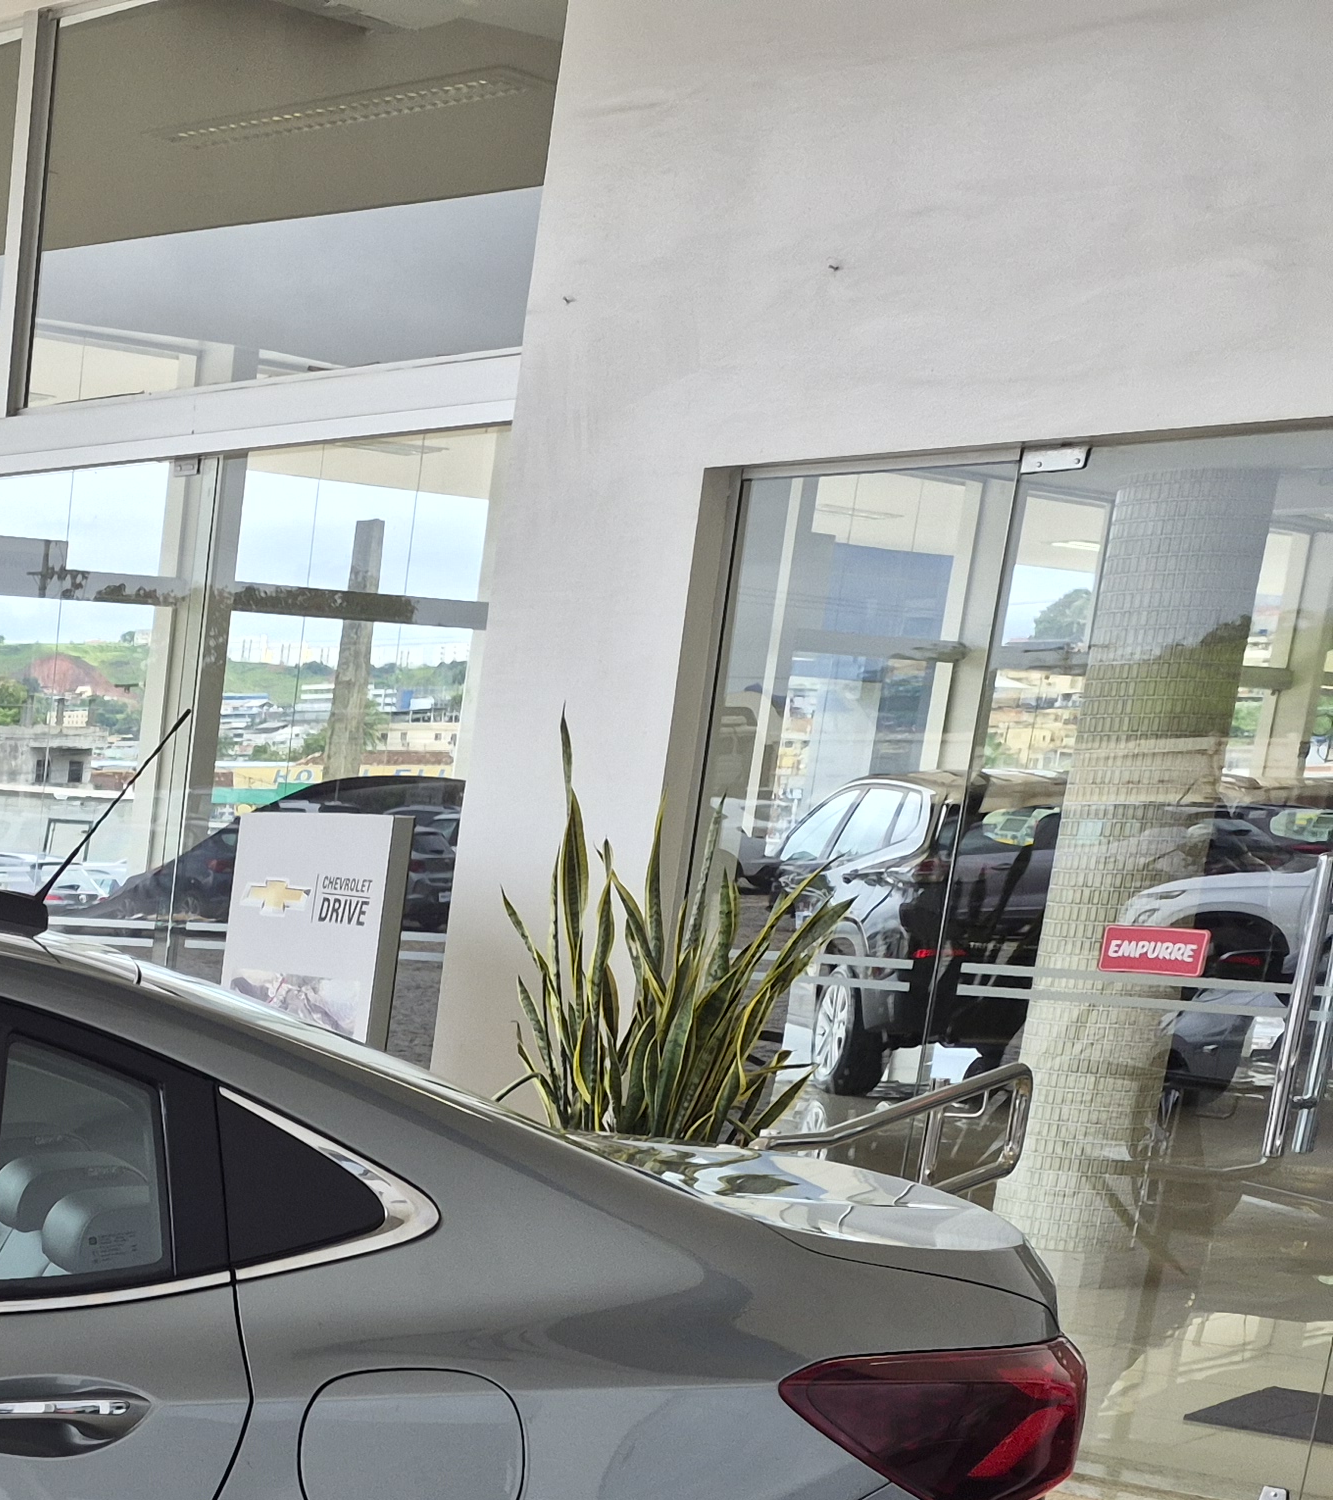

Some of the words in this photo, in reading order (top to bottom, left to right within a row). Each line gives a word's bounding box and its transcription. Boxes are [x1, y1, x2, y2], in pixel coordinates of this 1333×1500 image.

[322, 875, 373, 893] CHEVROLET
[318, 896, 370, 926] DRIVE
[1107, 939, 1198, 962] EMPURRE
